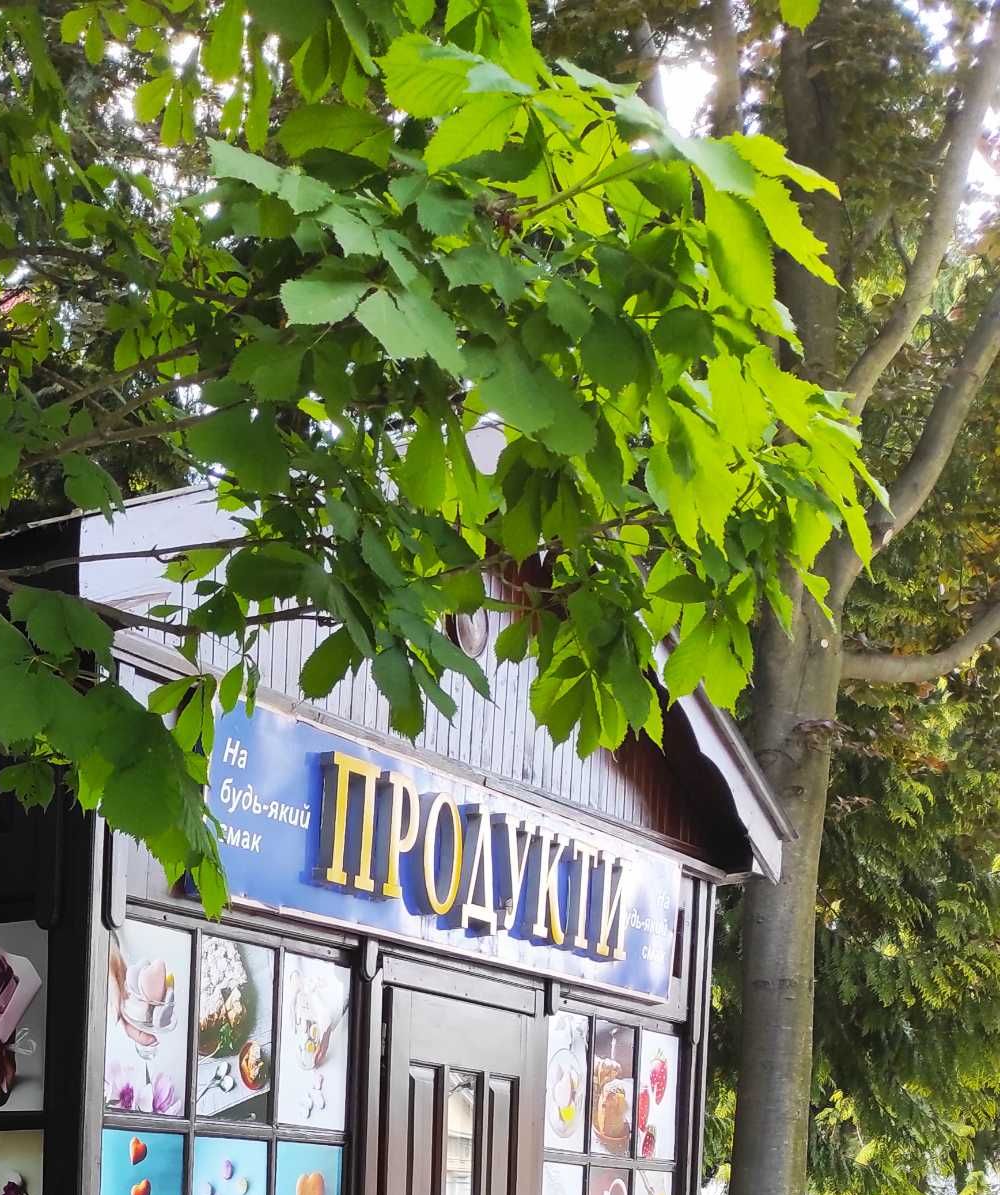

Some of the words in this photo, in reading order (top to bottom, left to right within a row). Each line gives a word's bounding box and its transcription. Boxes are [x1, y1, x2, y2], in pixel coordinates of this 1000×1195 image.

[222, 737, 248, 769] На
[220, 778, 311, 830] будь-який
[326, 751, 633, 961] ПРОДУКТИ
[624, 908, 669, 937] удь-який
